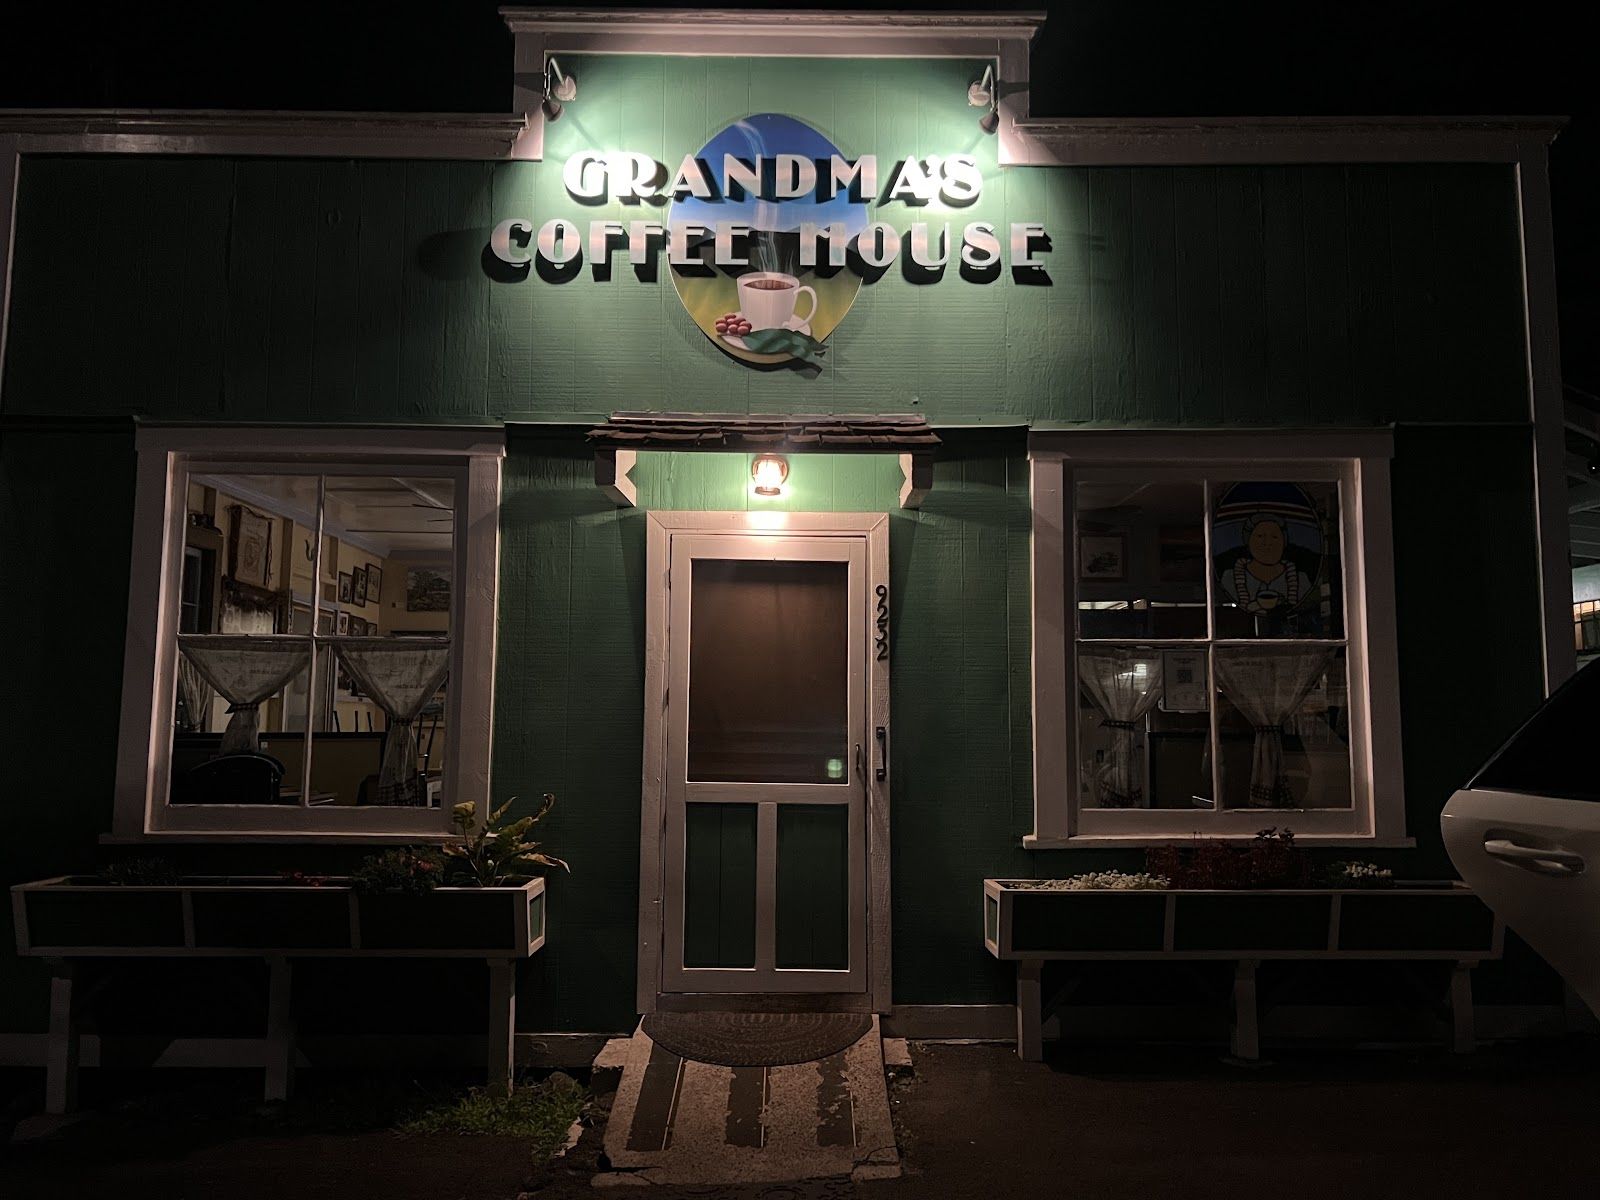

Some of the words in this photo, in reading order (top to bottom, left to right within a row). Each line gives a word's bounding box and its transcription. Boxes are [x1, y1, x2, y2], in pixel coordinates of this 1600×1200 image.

[563, 152, 983, 201] GRANDMA'S
[490, 218, 751, 268] COFFEE
[799, 220, 1047, 268] HOUSE
